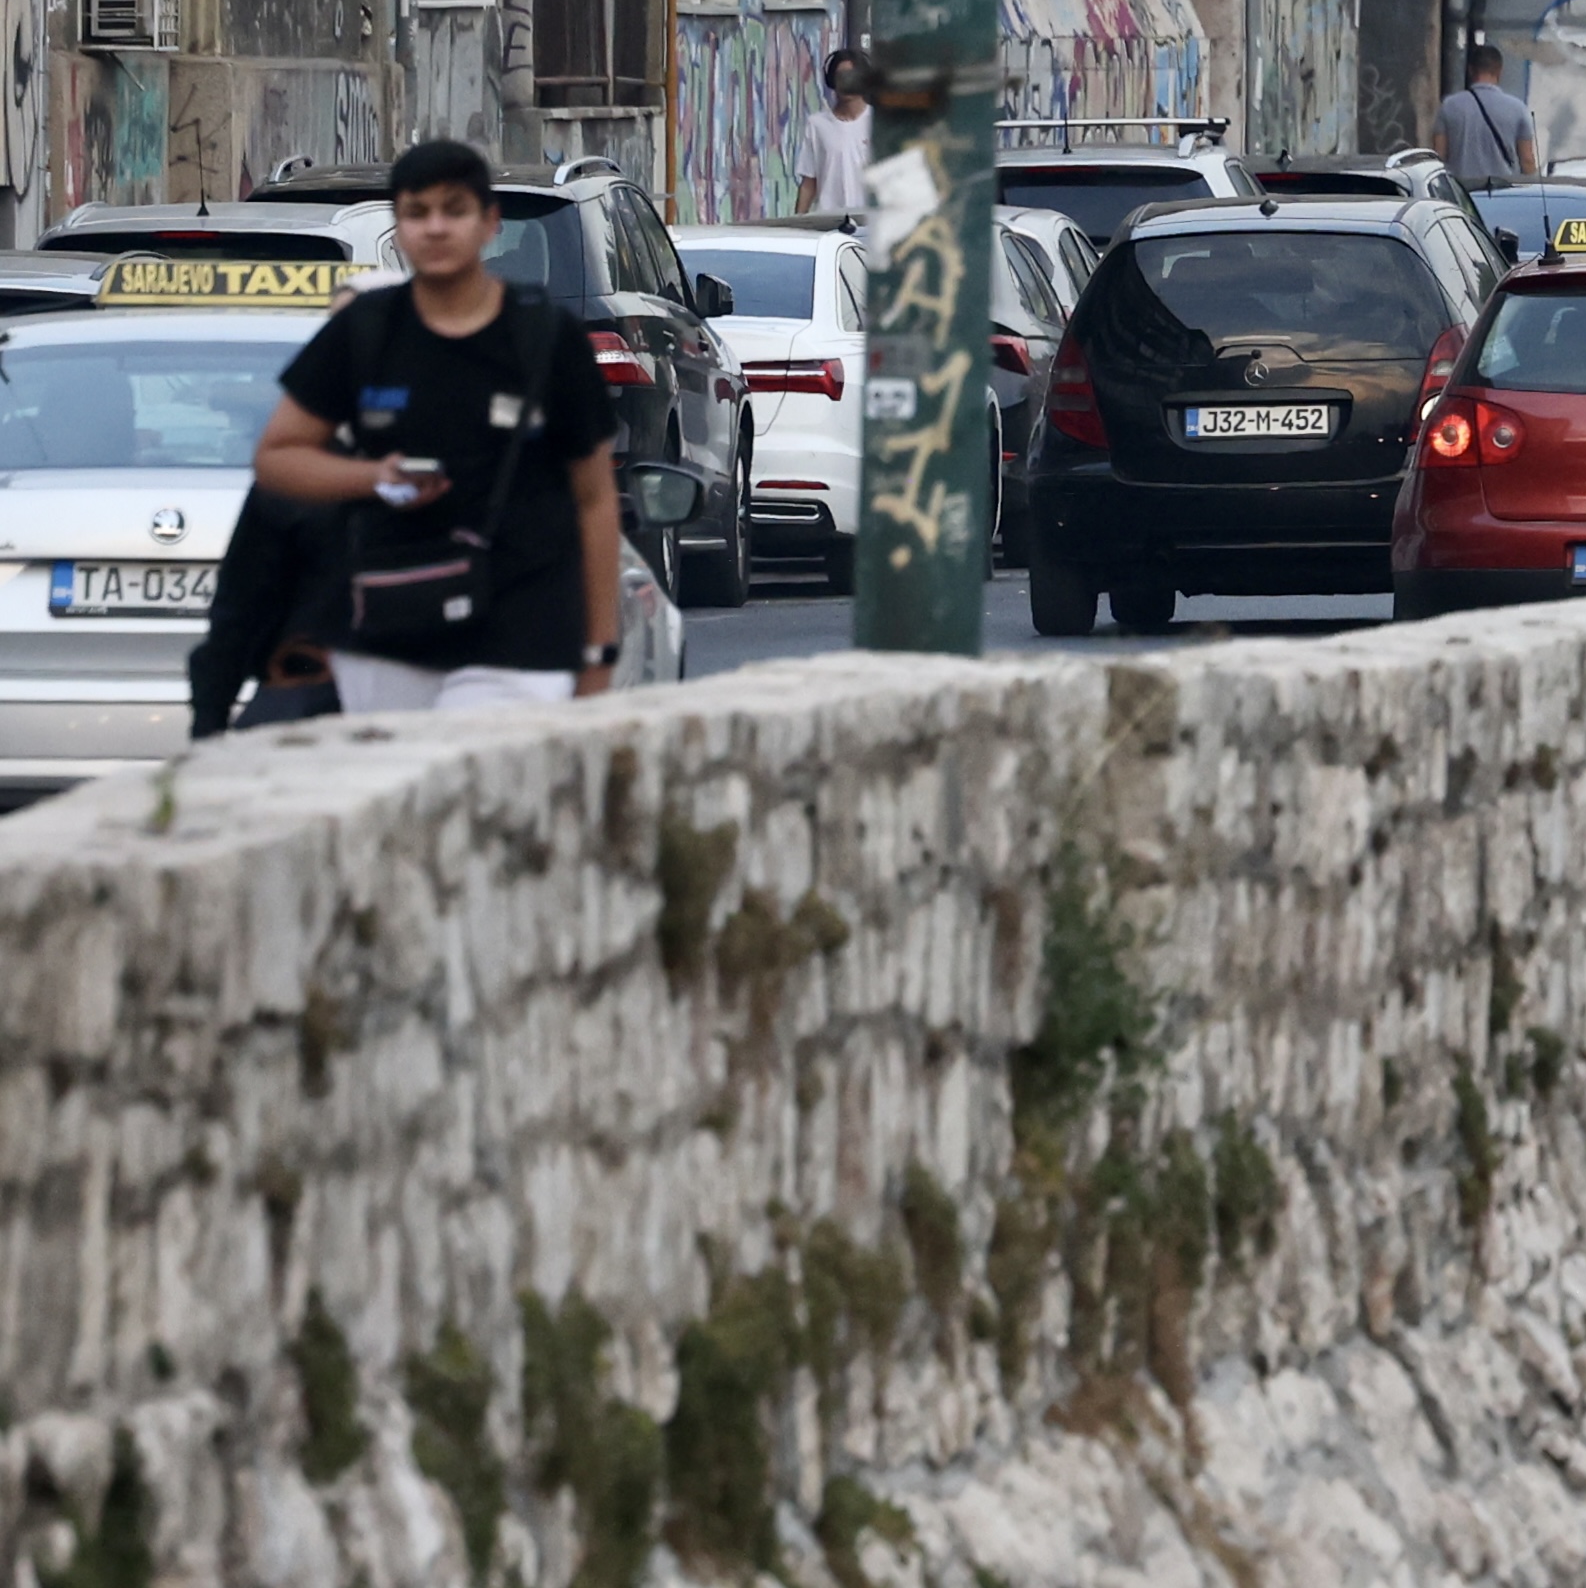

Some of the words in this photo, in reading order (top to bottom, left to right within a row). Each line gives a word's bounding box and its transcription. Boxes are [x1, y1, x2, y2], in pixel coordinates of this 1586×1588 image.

[121, 264, 215, 294] SARAJEVO
[217, 264, 331, 295] TAXI
[1203, 409, 1324, 433] J32-M-452
[78, 566, 214, 602] TA-034
